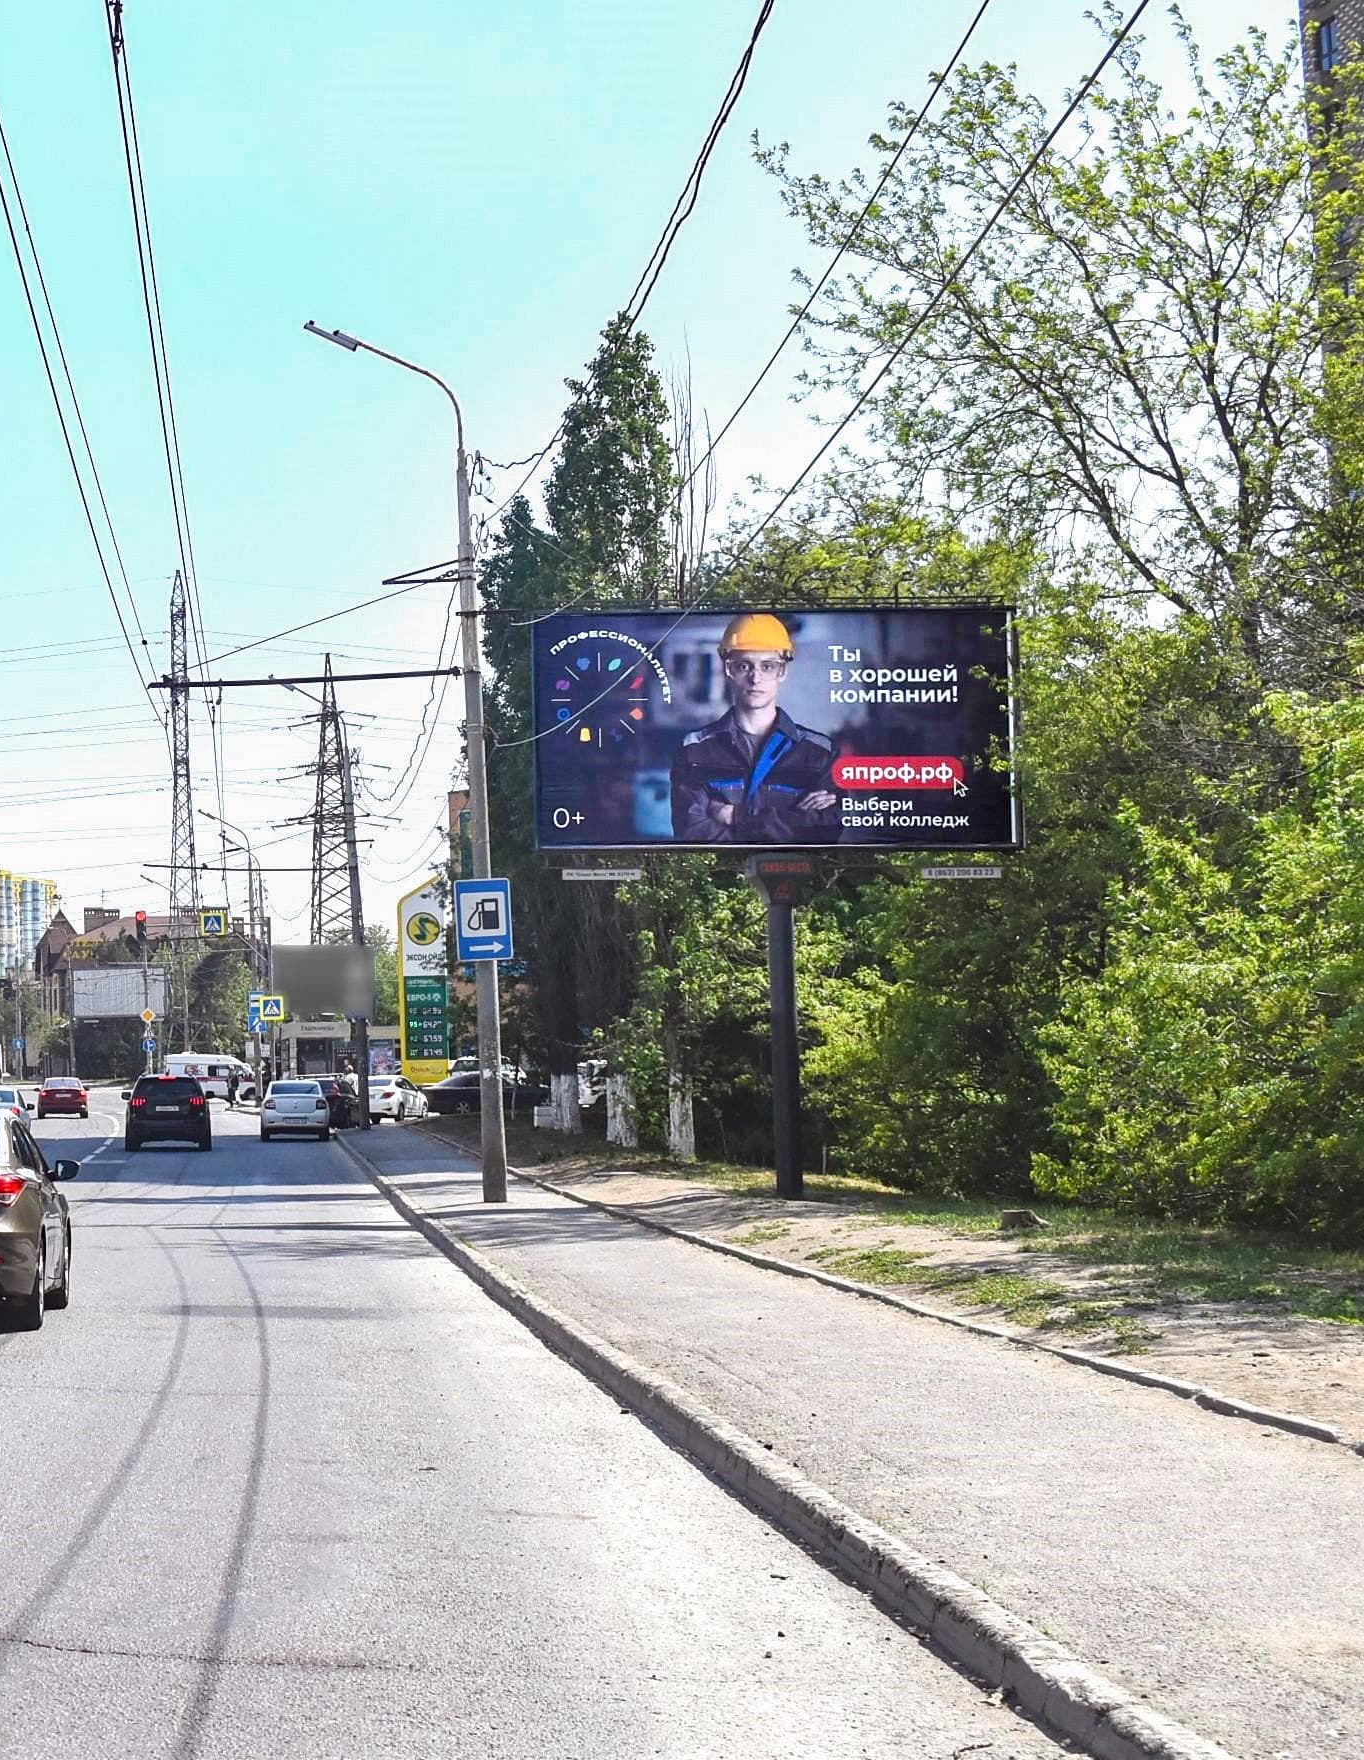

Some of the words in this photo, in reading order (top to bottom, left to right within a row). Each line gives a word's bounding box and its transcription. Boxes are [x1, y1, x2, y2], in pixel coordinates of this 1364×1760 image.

[828, 645, 861, 662] Ты
[549, 630, 672, 704] ПРОФЕССИОНАЛИТЕТ
[829, 669, 843, 683] в
[849, 664, 958, 687] хорошей
[830, 686, 958, 703] компании!
[841, 763, 953, 783] япроф.рф
[842, 797, 913, 813] Выбери
[552, 807, 586, 829] 0+
[841, 813, 884, 827] свой
[890, 815, 970, 828] колледж
